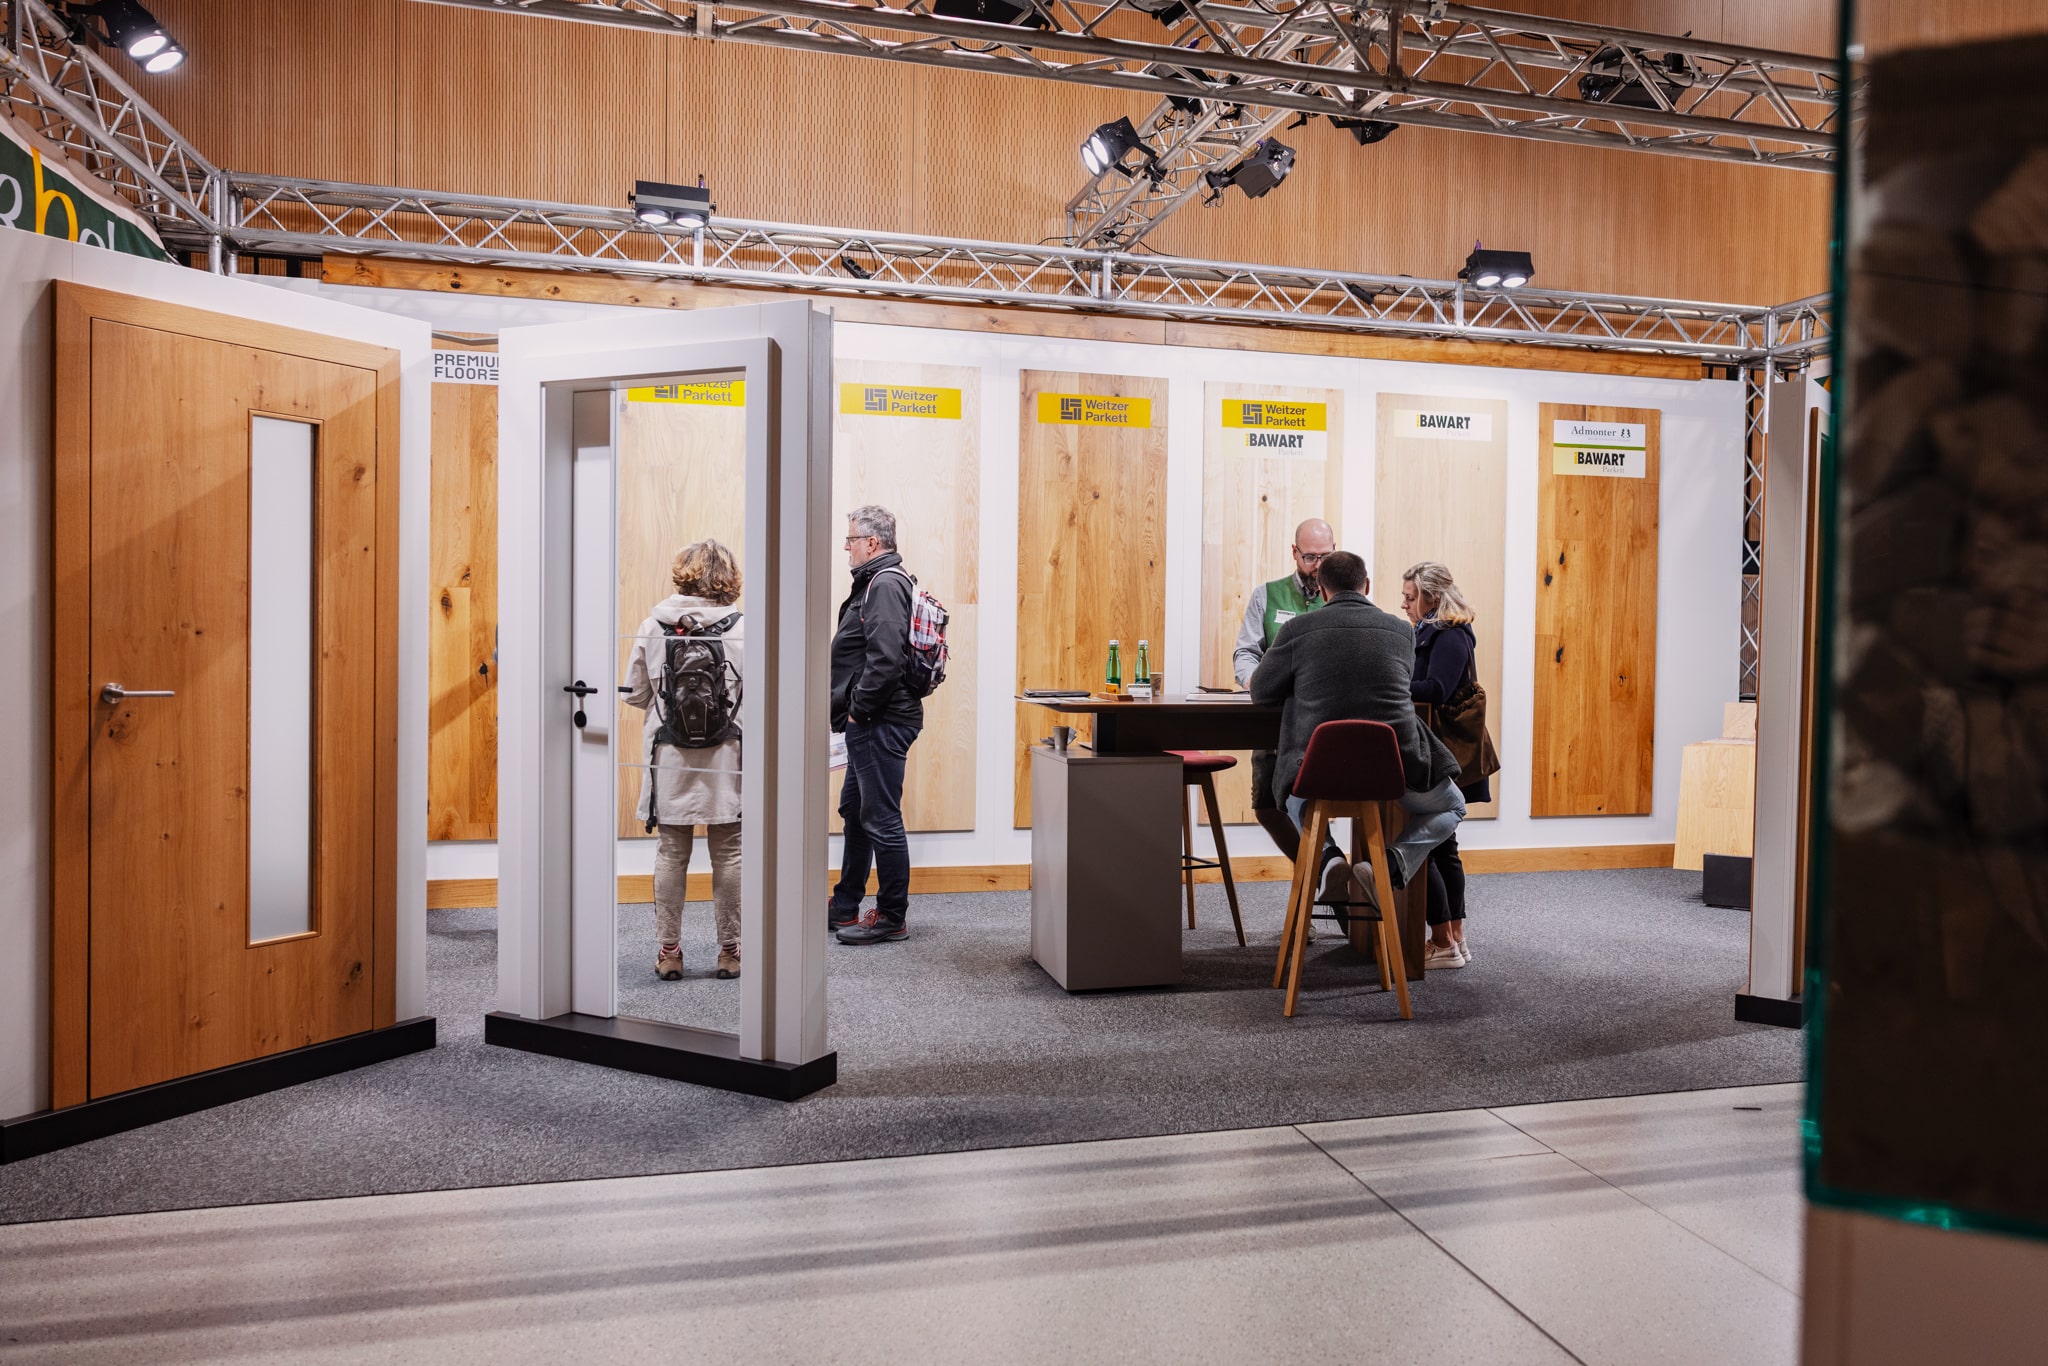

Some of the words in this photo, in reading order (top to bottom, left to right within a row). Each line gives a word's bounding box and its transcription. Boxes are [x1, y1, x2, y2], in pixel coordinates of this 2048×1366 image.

[434, 353, 499, 368] PREMIU
[683, 389, 733, 402] Parkett
[891, 389, 938, 402] Weitzer
[891, 401, 937, 414] Parkett
[1085, 399, 1129, 411] Weitzer
[1265, 404, 1307, 415] Weitzer
[1085, 411, 1128, 423] Parkett
[1265, 416, 1306, 427] Parkett
[1419, 414, 1471, 430] BAWART
[1571, 425, 1617, 437] Admonter
[1249, 432, 1304, 448] BAWART
[1577, 451, 1625, 466] BAWART
